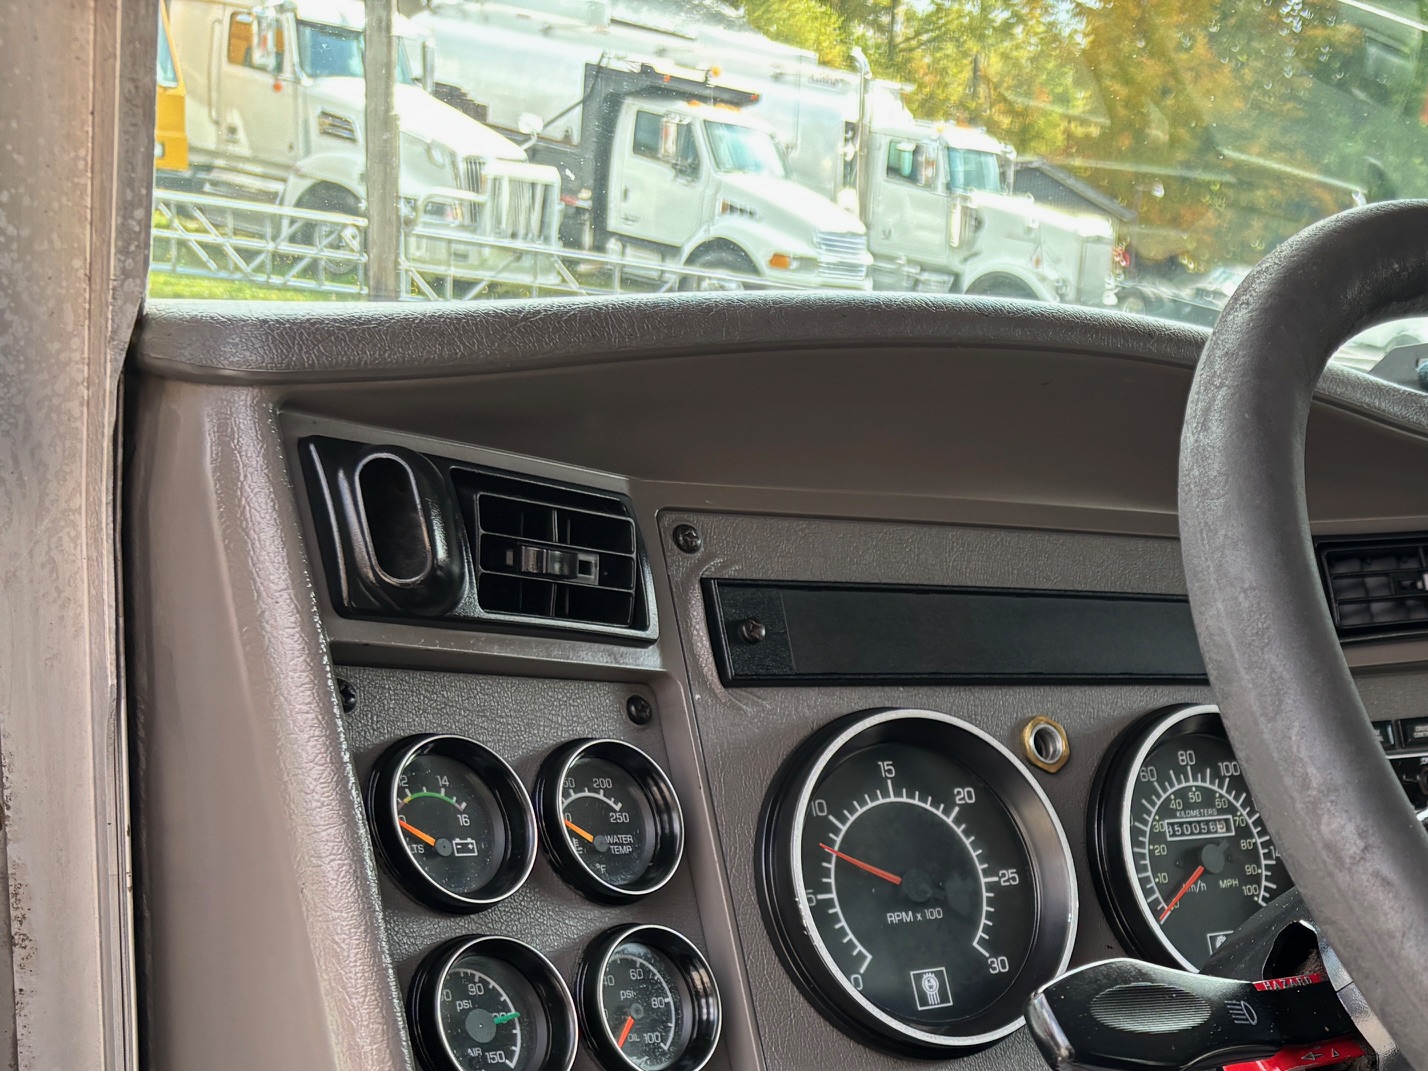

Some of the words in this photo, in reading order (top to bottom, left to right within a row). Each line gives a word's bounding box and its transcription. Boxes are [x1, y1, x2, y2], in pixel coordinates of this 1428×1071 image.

[1178, 750, 1195, 765] 80
[878, 761, 895, 777] 15
[1140, 766, 1157, 782] 60
[1218, 761, 1240, 776] 100
[436, 775, 450, 787] 14
[563, 777, 576, 788] 50
[593, 777, 613, 789] 200
[954, 787, 975, 804] 20
[1188, 791, 1202, 803] 50
[811, 800, 827, 816] 10
[1170, 799, 1183, 810] 40
[1215, 798, 1228, 809] 60
[609, 812, 630, 823] 250
[1176, 808, 1217, 818] KILOMETERS
[457, 814, 471, 826] 16
[1234, 817, 1246, 827] 70
[1153, 821, 1165, 832] 30
[604, 834, 634, 845] WATER
[1241, 839, 1253, 850] 80
[409, 844, 425, 854] LTS
[610, 845, 632, 855] TEMP
[1154, 845, 1167, 856] 20
[1245, 864, 1258, 875] 90
[999, 869, 1019, 886] 25
[1158, 873, 1168, 883] 10
[1219, 878, 1239, 889] MPH
[1243, 885, 1259, 896] 100
[806, 889, 817, 906] 5
[887, 911, 914, 924] RPM
[916, 913, 923, 921] x
[924, 907, 943, 920] 100
[988, 956, 1009, 974] 30
[629, 968, 644, 980] 60
[851, 974, 863, 991] 0
[1263, 976, 1313, 991] HAZARD
[468, 983, 484, 996] 90
[620, 990, 635, 1001] psi
[456, 1000, 472, 1012] psi
[651, 997, 666, 1009] 80
[628, 1034, 640, 1042] OIL
[643, 1032, 661, 1044] 100
[467, 1047, 482, 1057] AIR
[485, 1051, 506, 1064] 150
